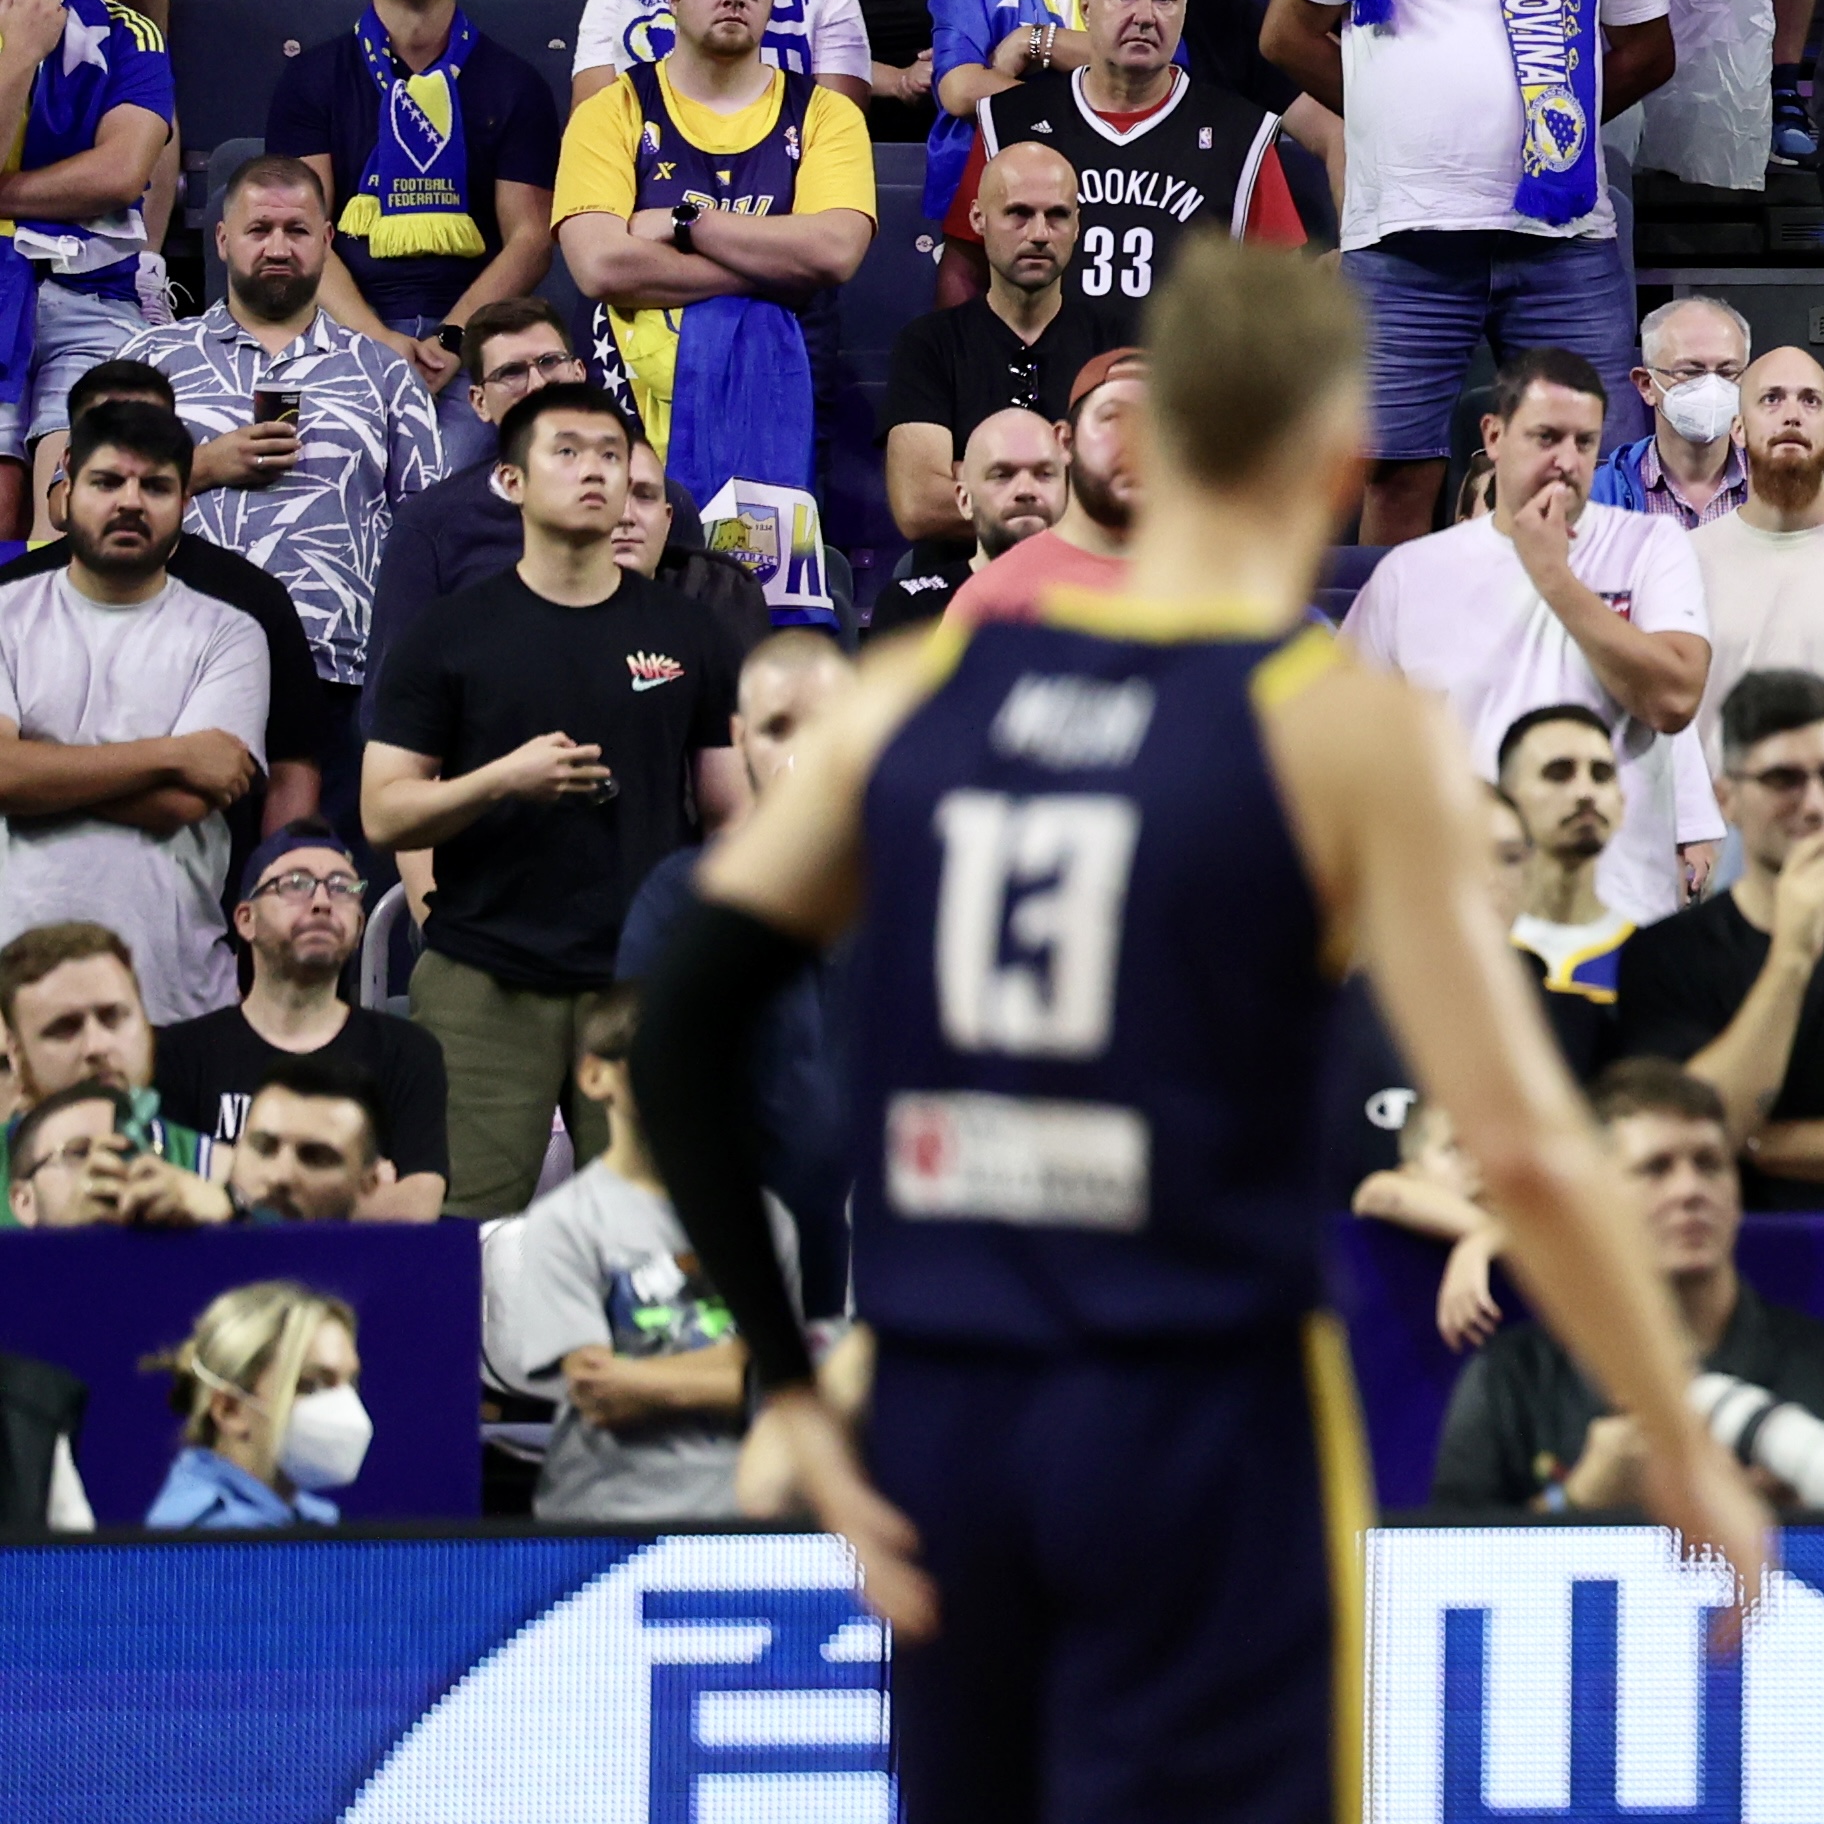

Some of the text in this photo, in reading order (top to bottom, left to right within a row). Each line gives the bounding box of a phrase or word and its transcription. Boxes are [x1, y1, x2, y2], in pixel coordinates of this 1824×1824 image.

[387, 190, 461, 208] FEDERATION
[392, 177, 456, 194] FOOTBALL
[1077, 167, 1205, 224] OOKLYN
[1080, 225, 1154, 299] 33
[933, 788, 1142, 1062] 13
